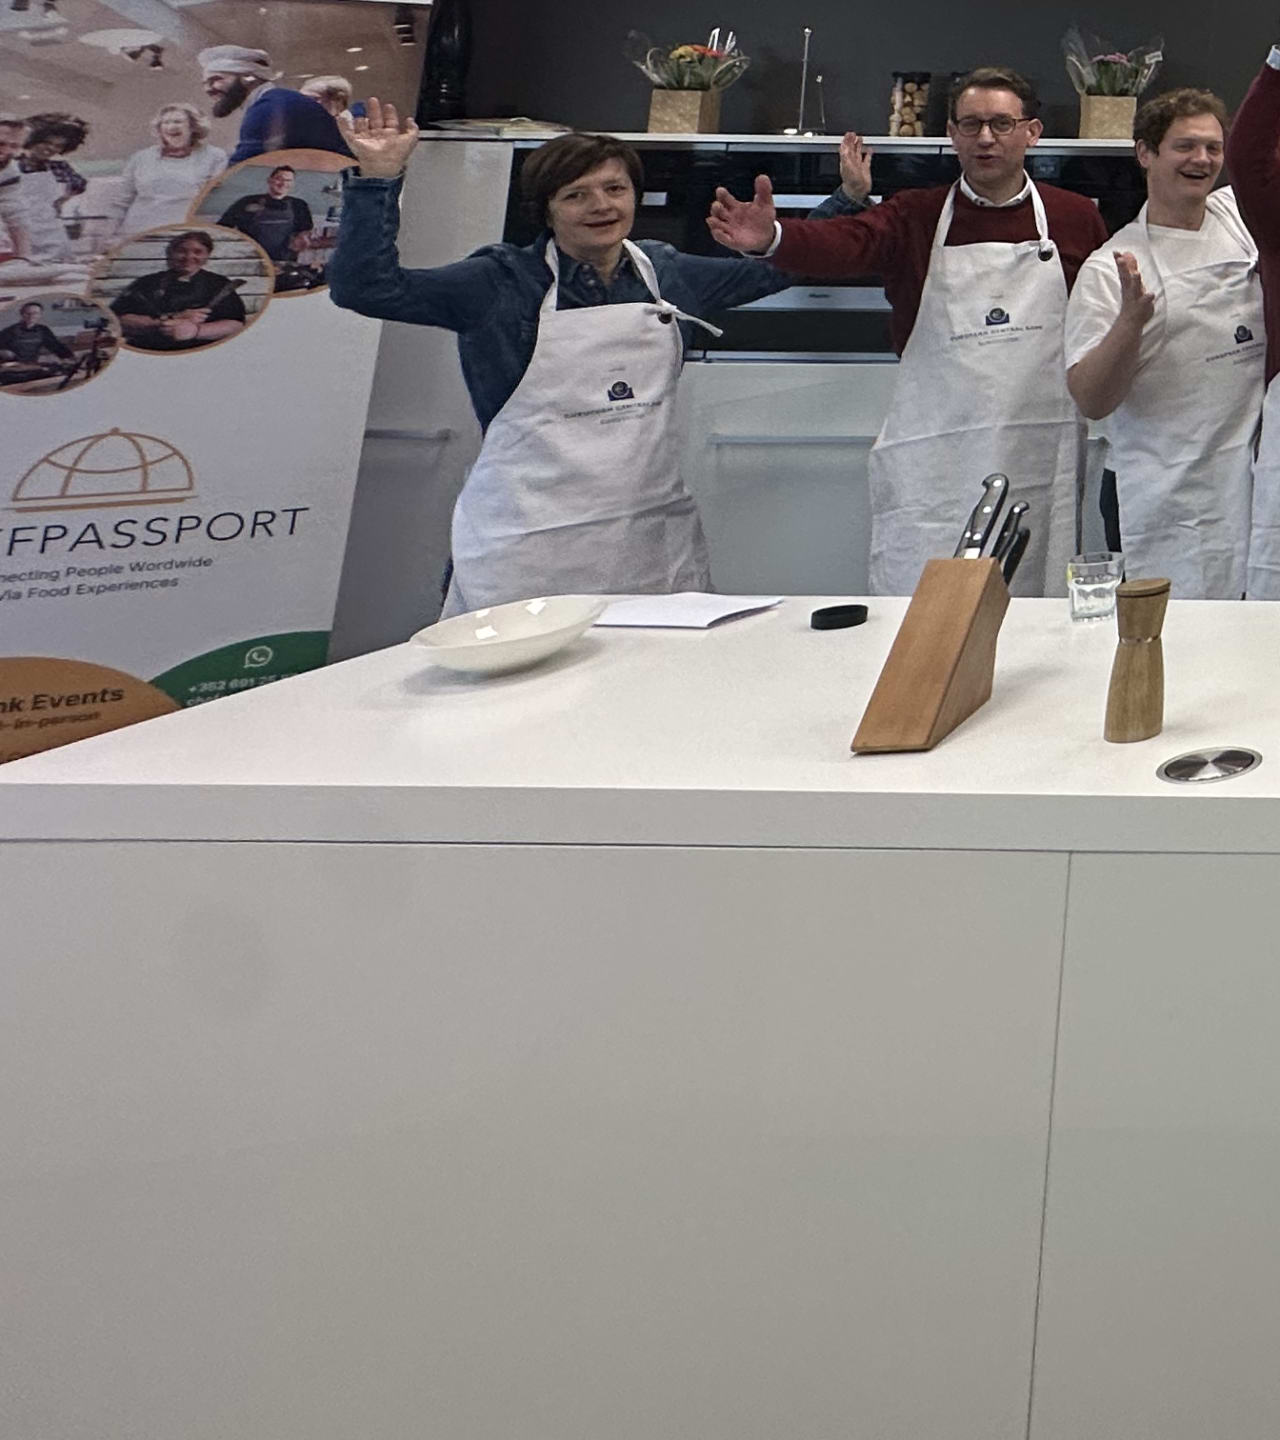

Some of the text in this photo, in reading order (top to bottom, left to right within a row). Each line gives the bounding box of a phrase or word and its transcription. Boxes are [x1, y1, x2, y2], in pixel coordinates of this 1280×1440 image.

[0, 506, 310, 557] FPASSPORT
[66, 563, 124, 578] People
[129, 555, 214, 573] Wordwide
[27, 584, 71, 599] Food
[76, 576, 179, 596] Experiences
[31, 687, 124, 711] Events
